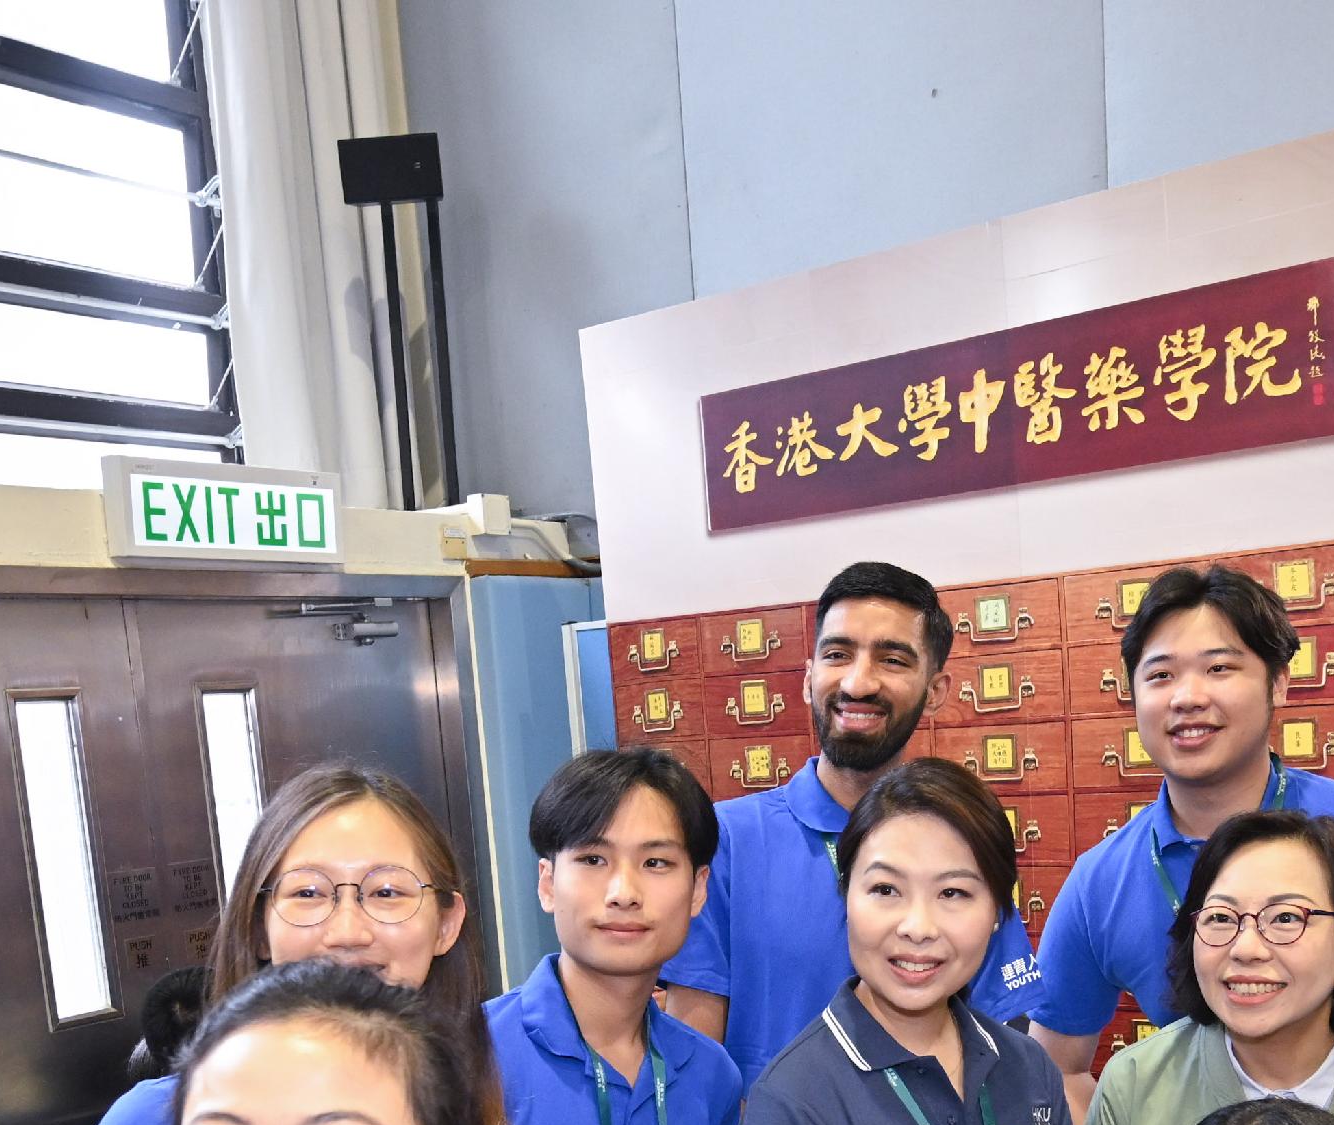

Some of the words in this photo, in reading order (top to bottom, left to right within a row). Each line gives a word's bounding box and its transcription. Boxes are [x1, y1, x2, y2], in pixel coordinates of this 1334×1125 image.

[722, 321, 1302, 494] 香港大學中醫藥學院
[142, 481, 240, 545] EXIT
[255, 491, 326, 548] 出口
[129, 939, 152, 951] PUSH
[1005, 970, 1041, 990] YOUTH
